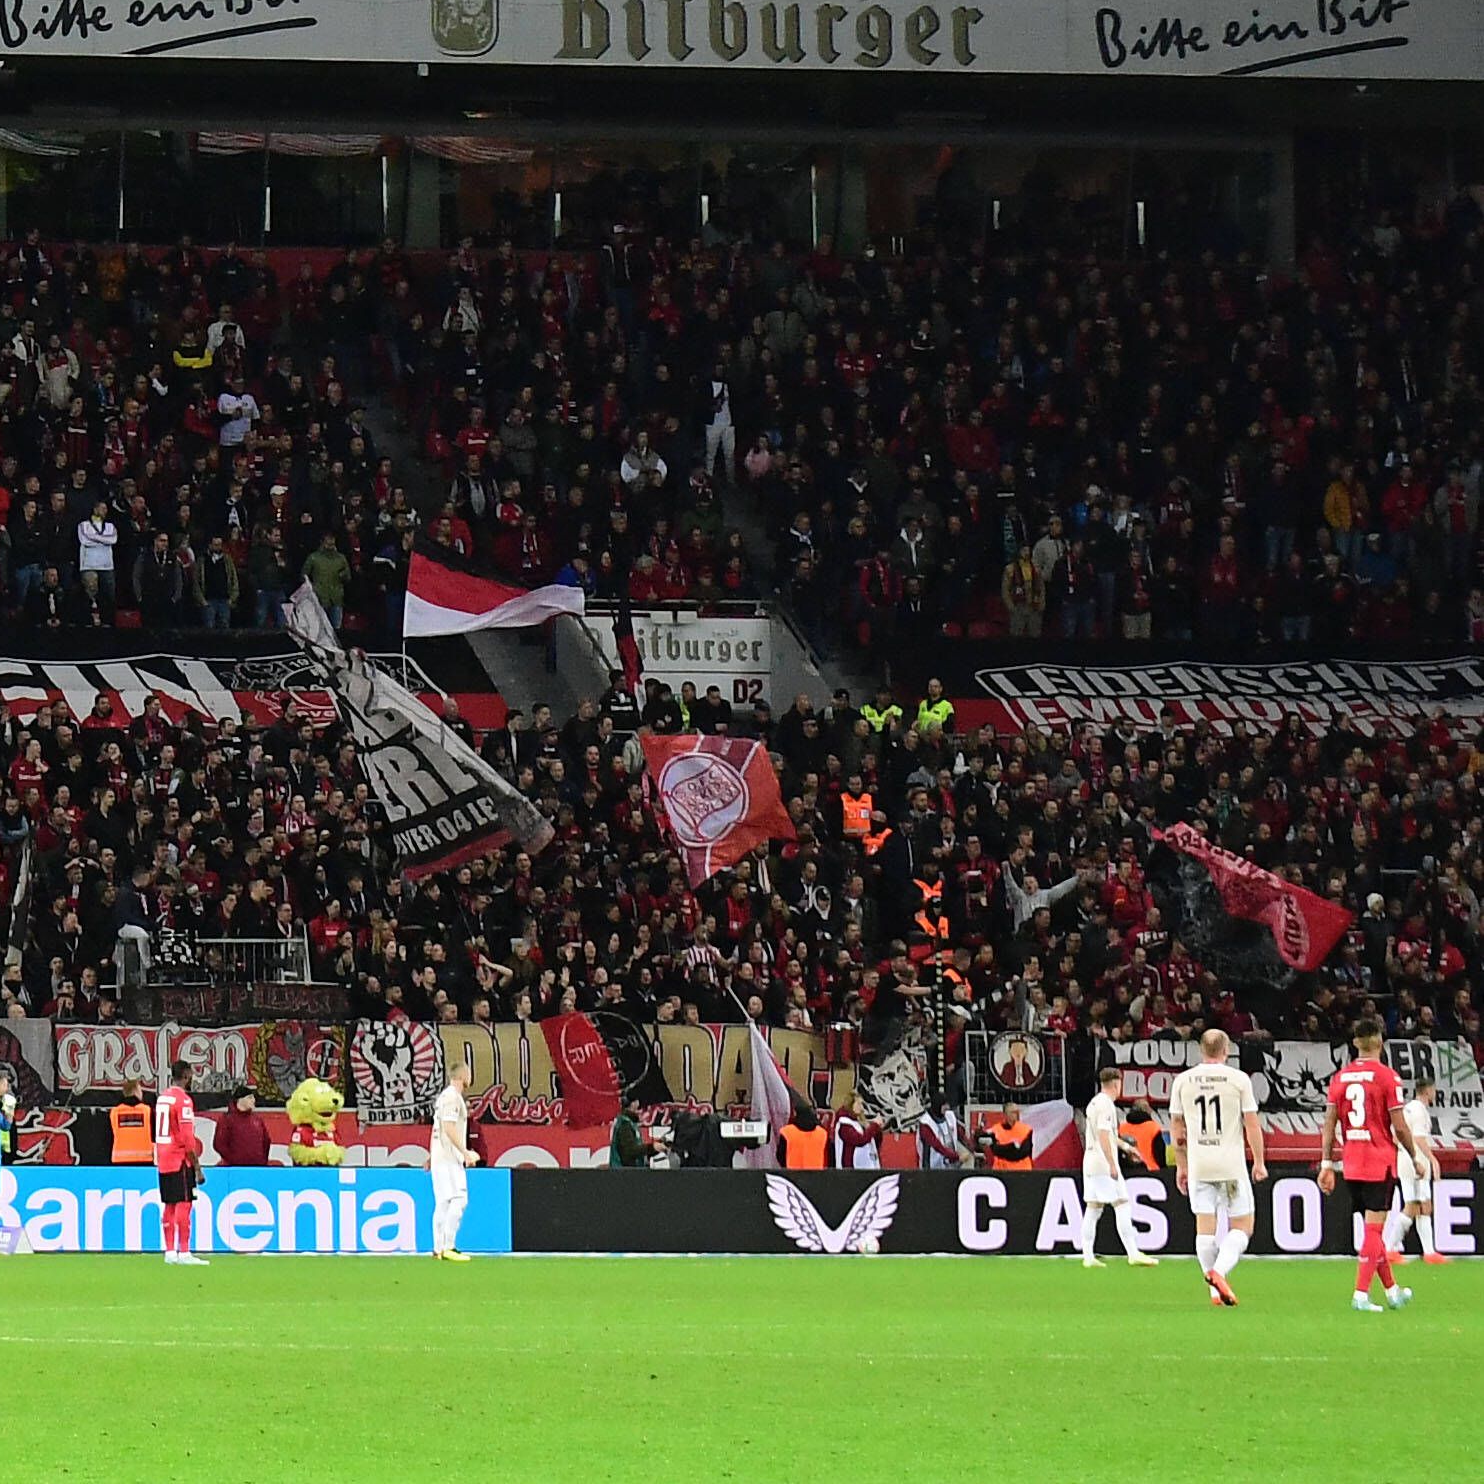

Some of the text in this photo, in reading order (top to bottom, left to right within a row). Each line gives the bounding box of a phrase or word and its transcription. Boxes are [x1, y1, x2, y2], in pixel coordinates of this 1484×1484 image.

[1094, 8, 1210, 68] Bitte
[1222, 15, 1308, 52] ein
[637, 620, 764, 666] itburger
[733, 678, 764, 704] D2
[393, 824, 442, 855] AYER
[435, 809, 473, 841] 04
[1194, 1094, 1223, 1135] 11
[1345, 1083, 1366, 1129] 3
[957, 1175, 1478, 1253] CASOE
